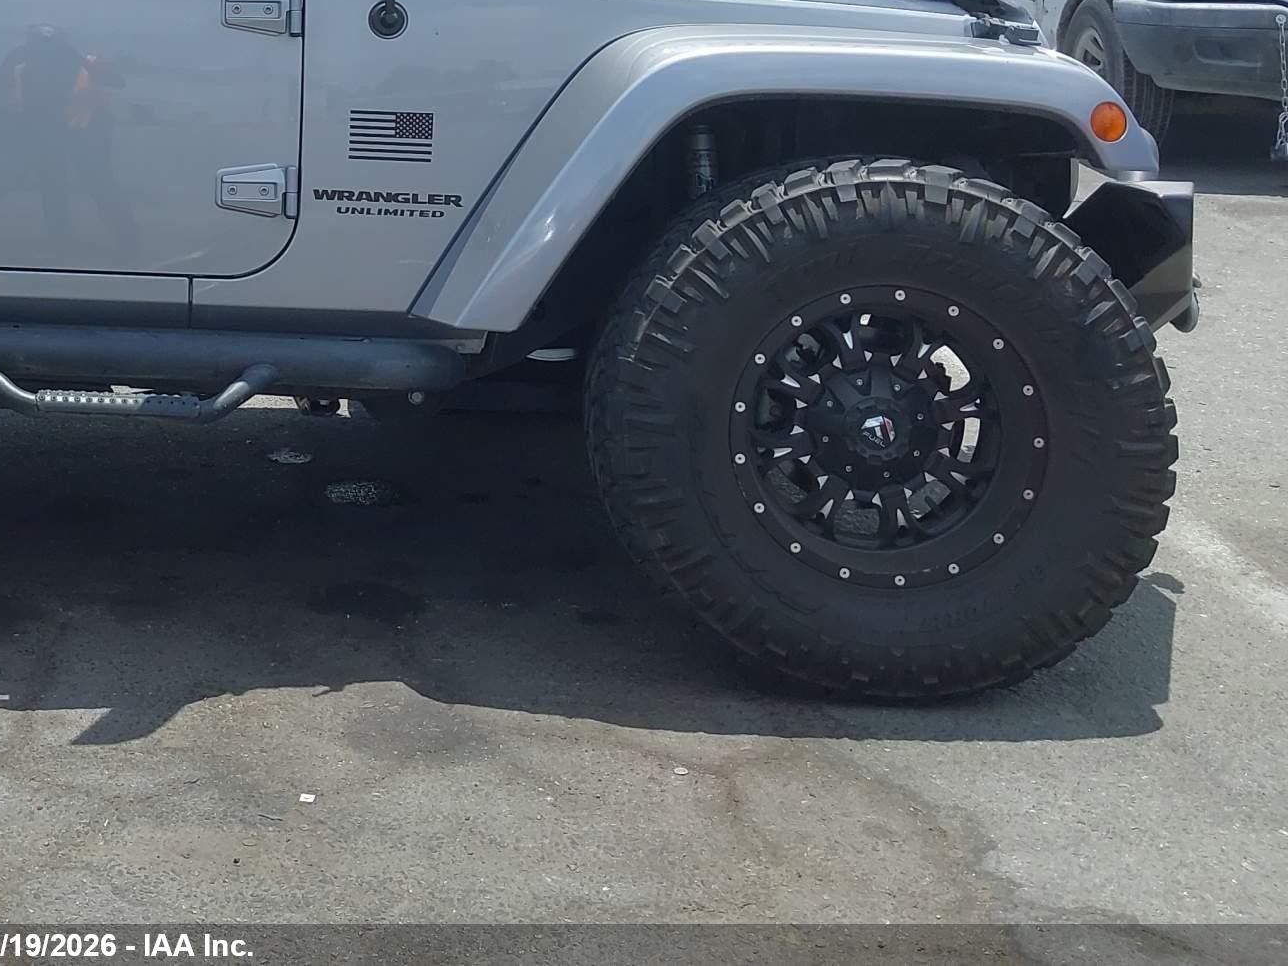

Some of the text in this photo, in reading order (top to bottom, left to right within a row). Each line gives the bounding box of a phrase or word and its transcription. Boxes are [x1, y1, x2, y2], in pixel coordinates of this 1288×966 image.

[312, 188, 464, 208] WRANGLER
[336, 206, 445, 218] UNLIMITED
[862, 430, 886, 447] FUEL
